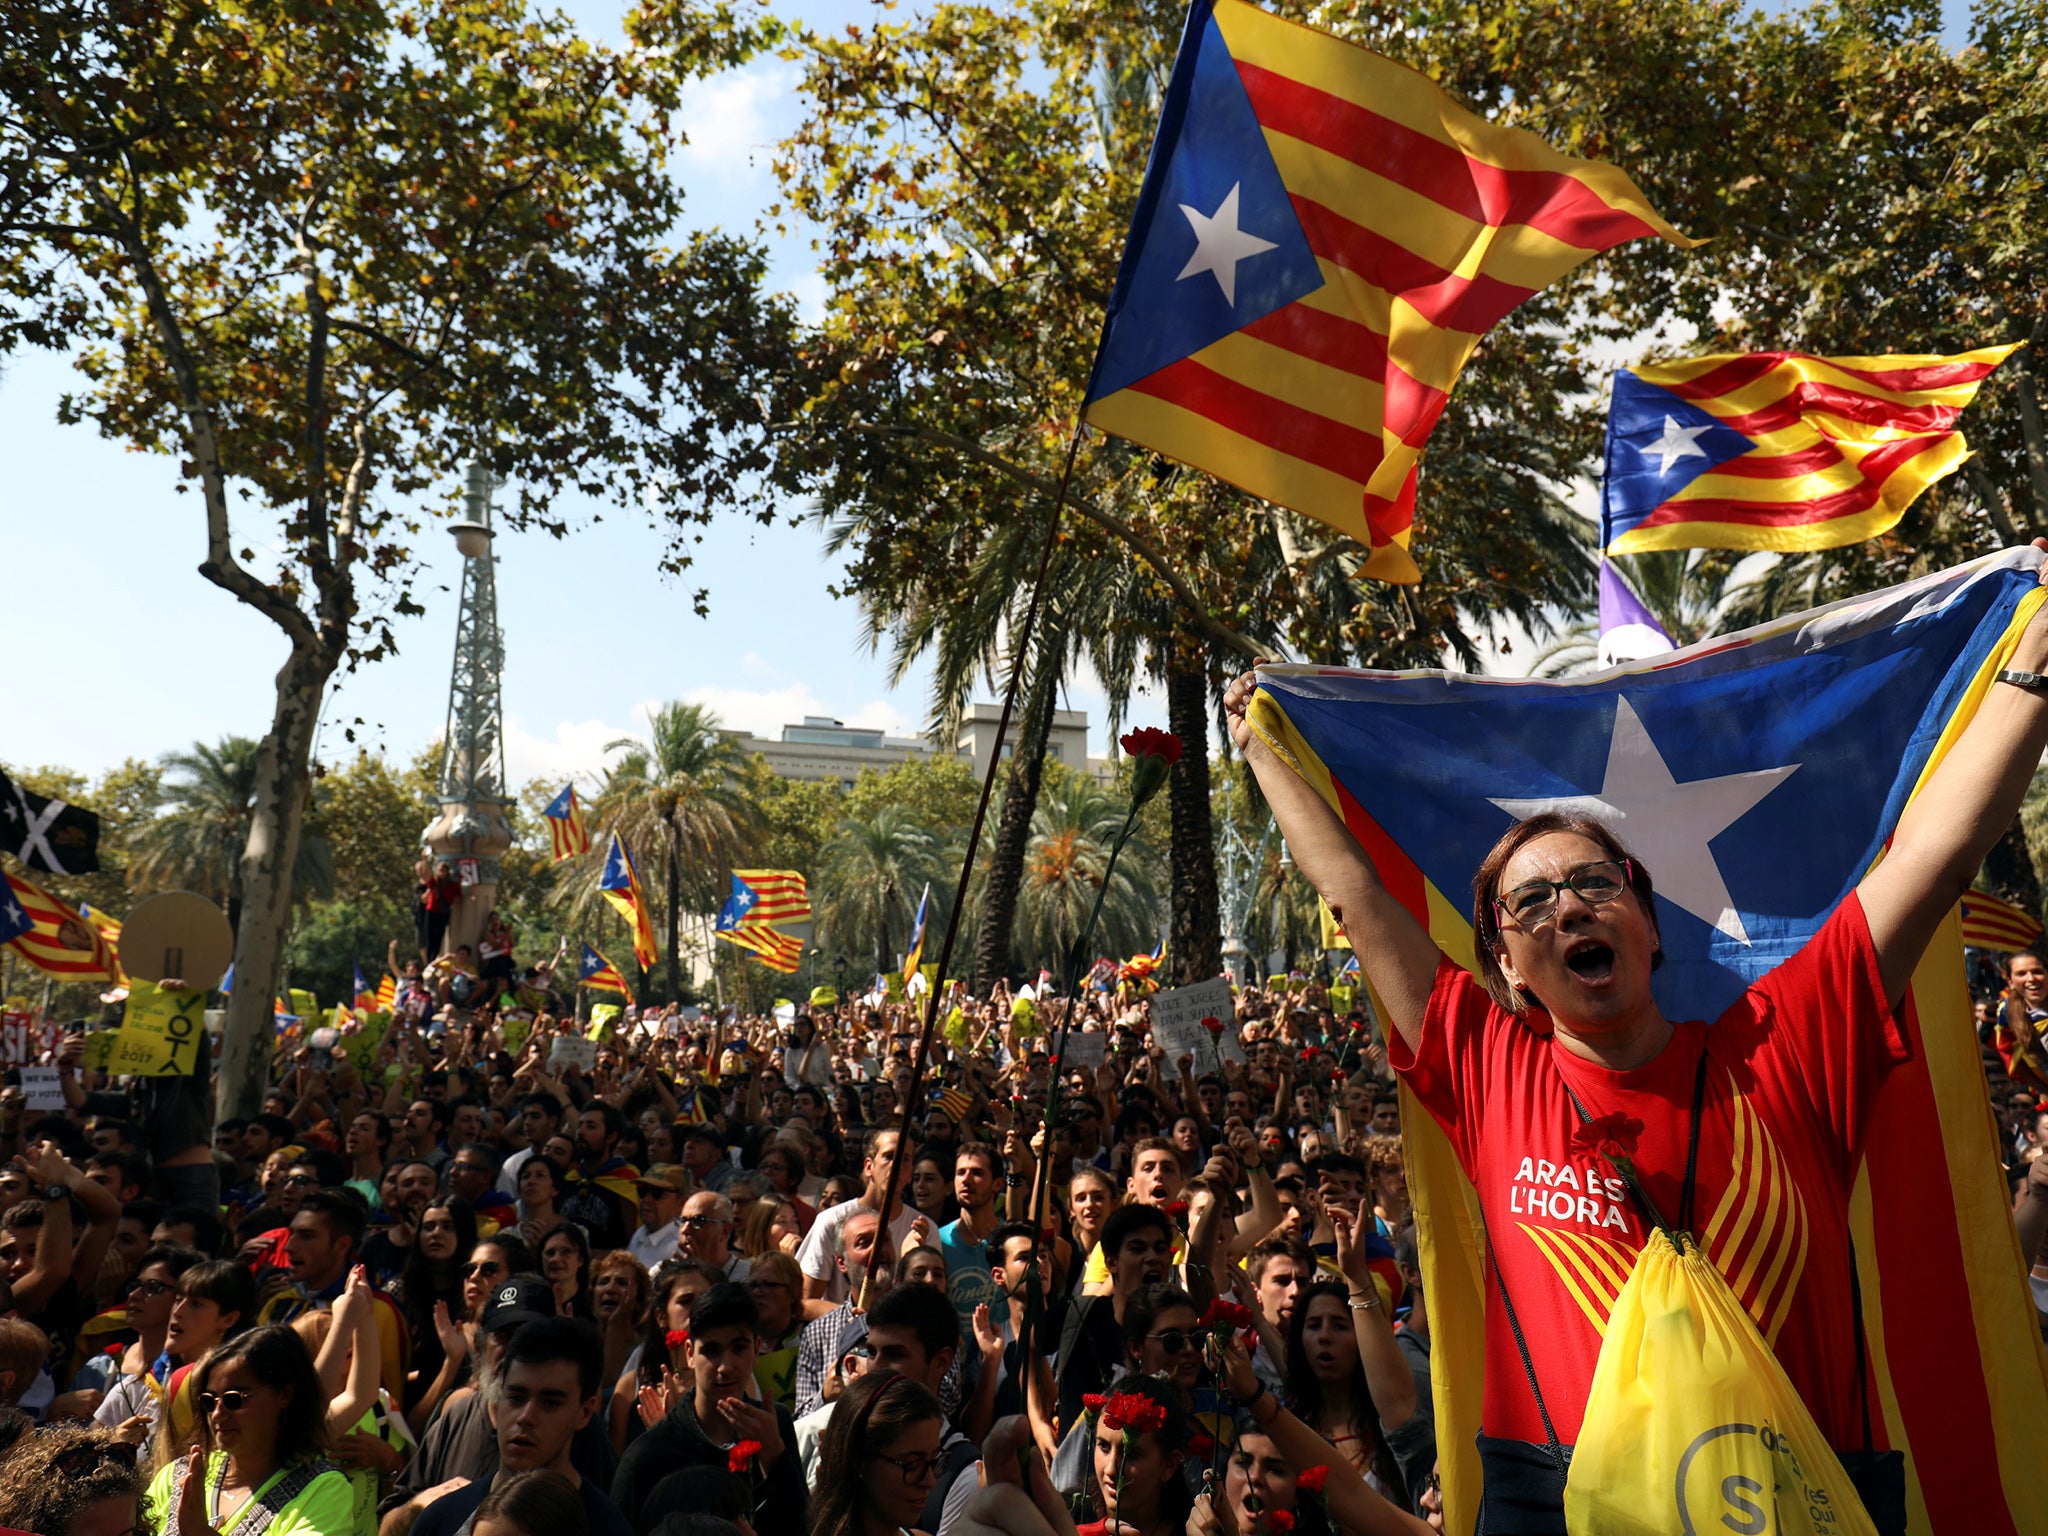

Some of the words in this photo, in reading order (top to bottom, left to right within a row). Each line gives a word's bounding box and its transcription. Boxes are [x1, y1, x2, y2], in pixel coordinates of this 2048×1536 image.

[120, 1051, 153, 1063] 2017
[1513, 1156, 1580, 1191] ARA
[1510, 1185, 1629, 1234] L'HORA
[1809, 1505, 1836, 1523] Oui
